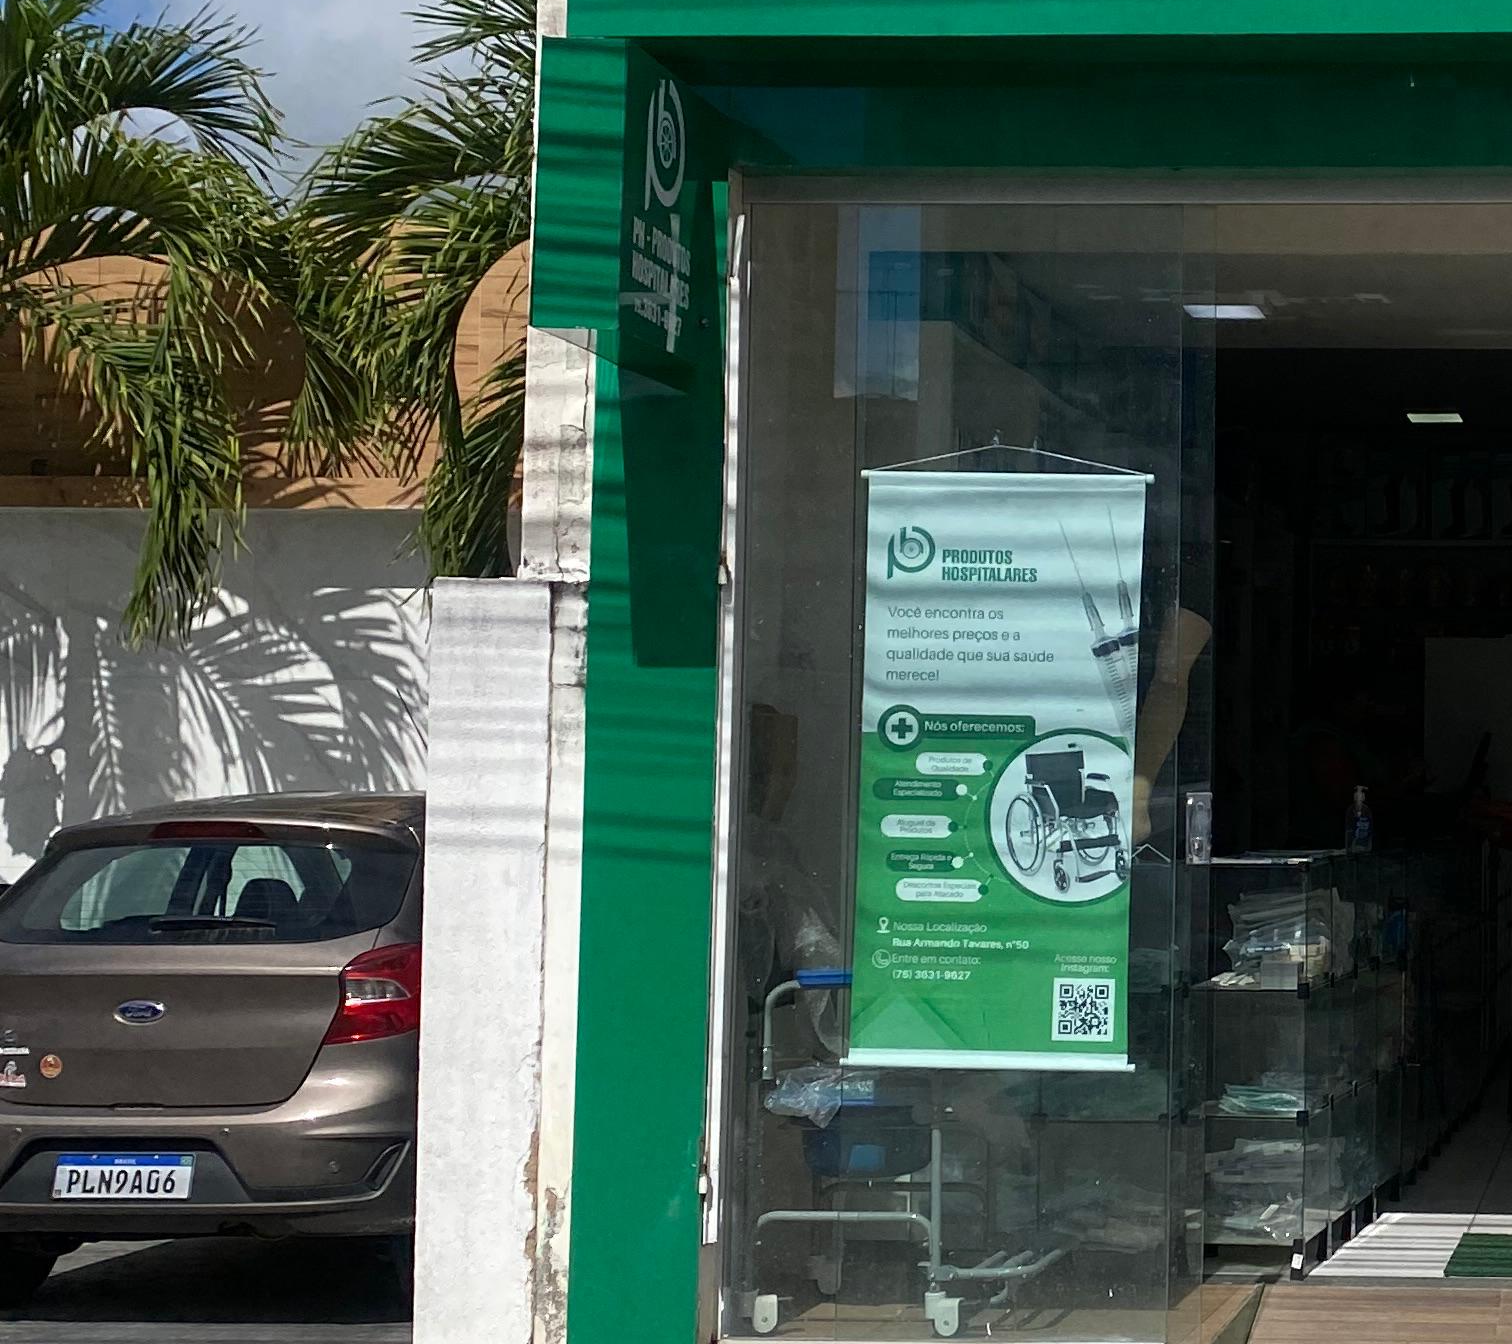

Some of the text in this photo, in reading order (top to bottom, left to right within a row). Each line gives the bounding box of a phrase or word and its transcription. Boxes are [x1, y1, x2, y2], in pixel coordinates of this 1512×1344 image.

[942, 549, 1013, 565] PRODUTOS
[942, 567, 1038, 583] HOSPITALARES
[888, 605, 1004, 621] Você encontra os
[887, 627, 1021, 643] melhores preços e a
[886, 648, 1055, 663] qualidade que sua saúde
[886, 669, 940, 682] merece!
[924, 720, 1025, 734] Nós oferecemos:
[893, 921, 925, 932] Nossa
[892, 937, 912, 947] Rua
[913, 937, 961, 948] Armando
[892, 953, 918, 964] Entre
[920, 955, 937, 964] em
